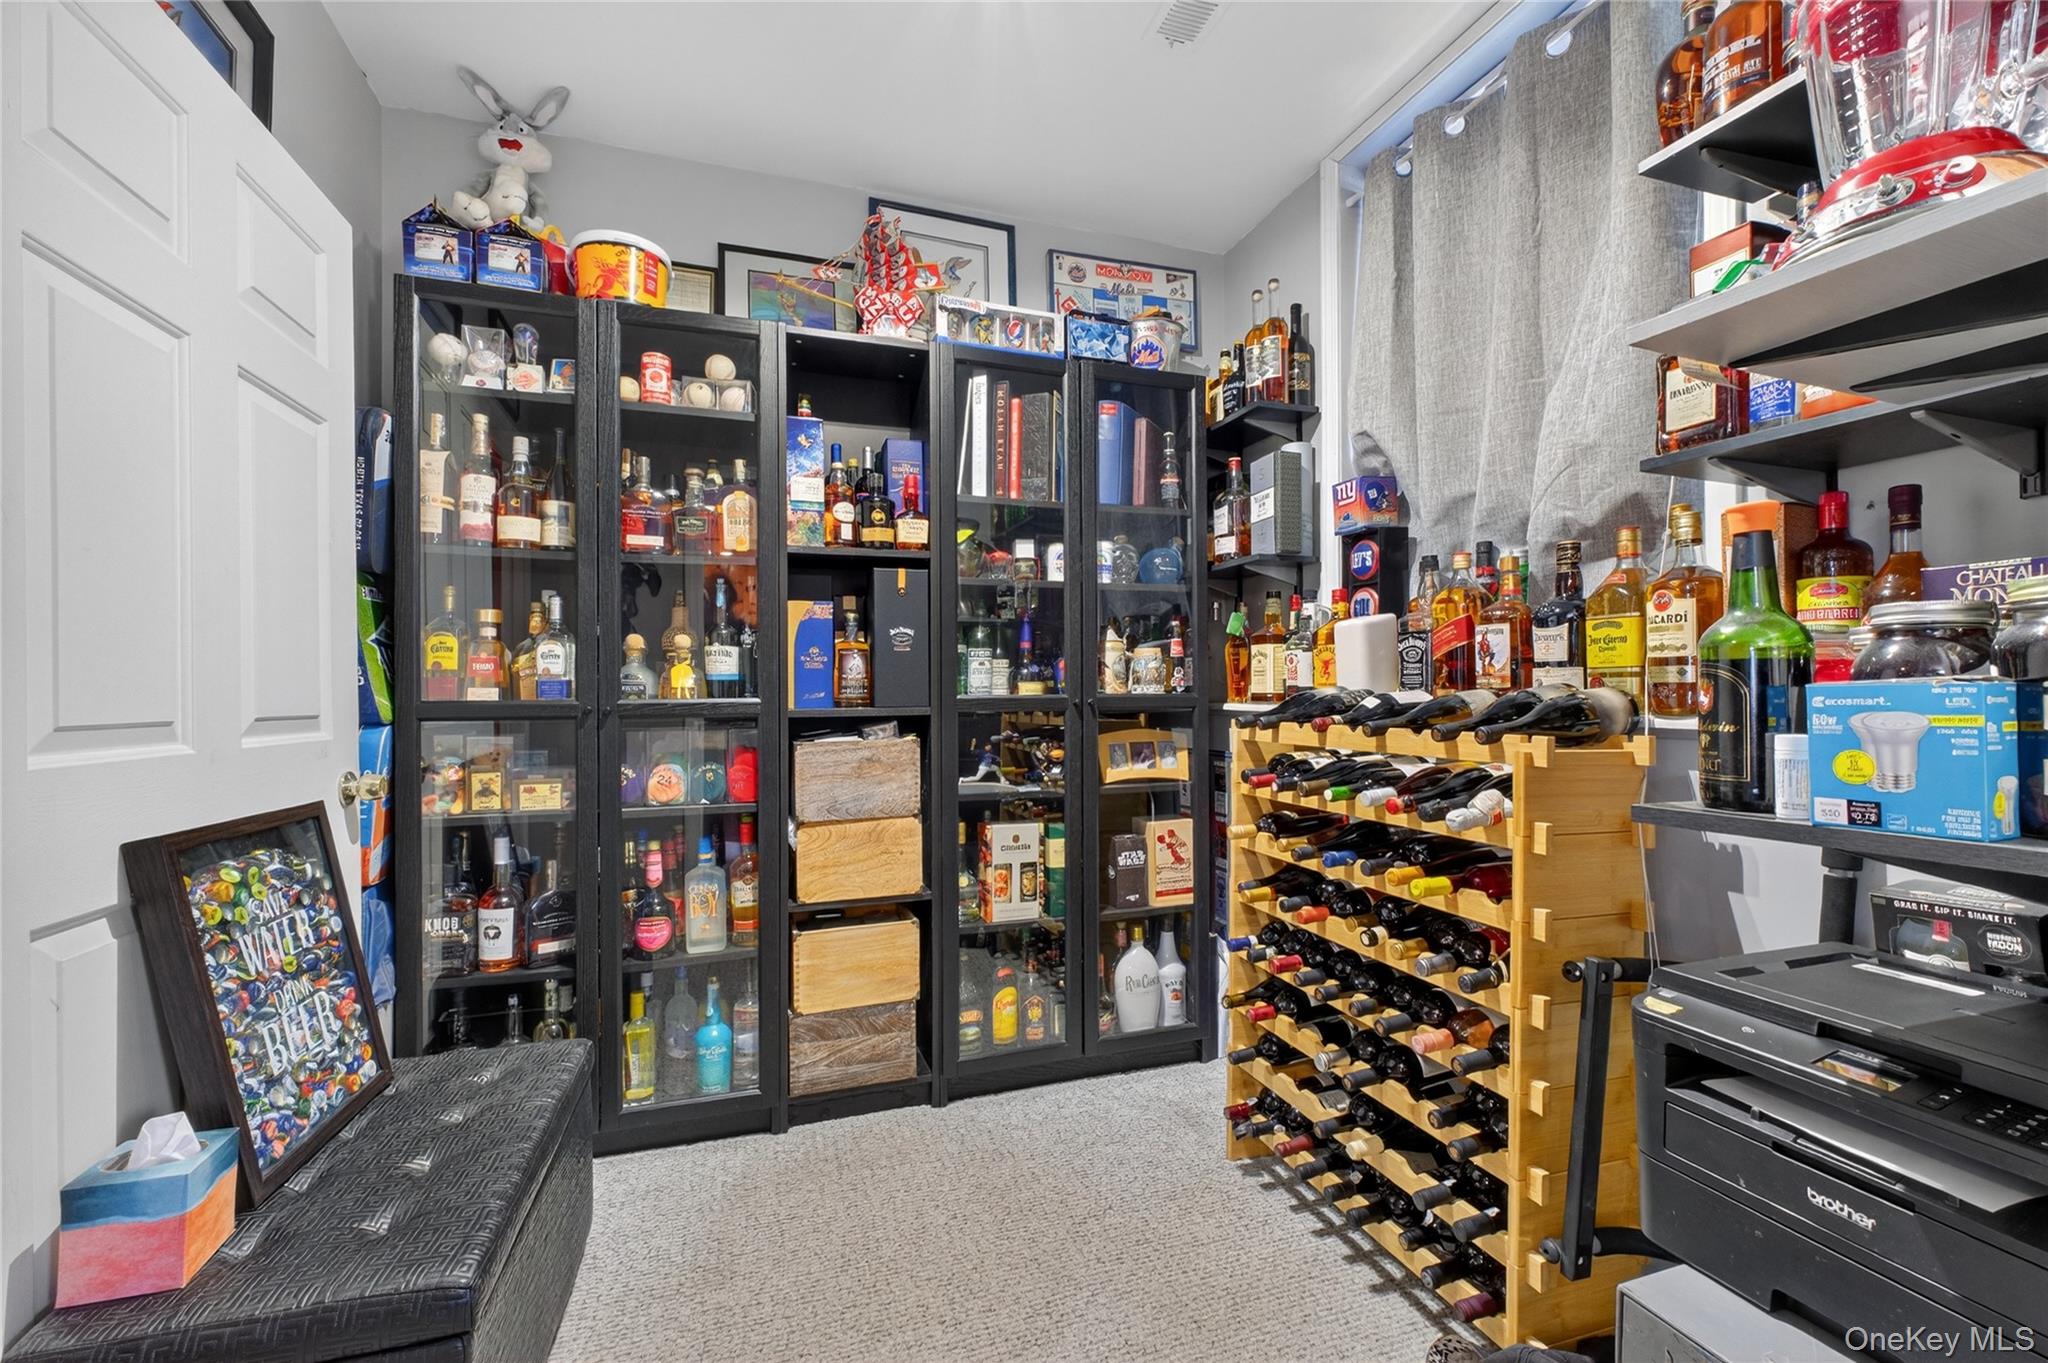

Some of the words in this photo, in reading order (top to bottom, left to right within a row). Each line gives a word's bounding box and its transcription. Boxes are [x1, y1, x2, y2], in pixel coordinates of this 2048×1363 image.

[249, 891, 291, 924] SAVE
[1893, 900, 1918, 911] GRAB
[238, 909, 316, 979] WATER
[274, 978, 315, 1014] DRINK
[261, 991, 341, 1076] BEER
[1806, 1186, 1877, 1231] brother
